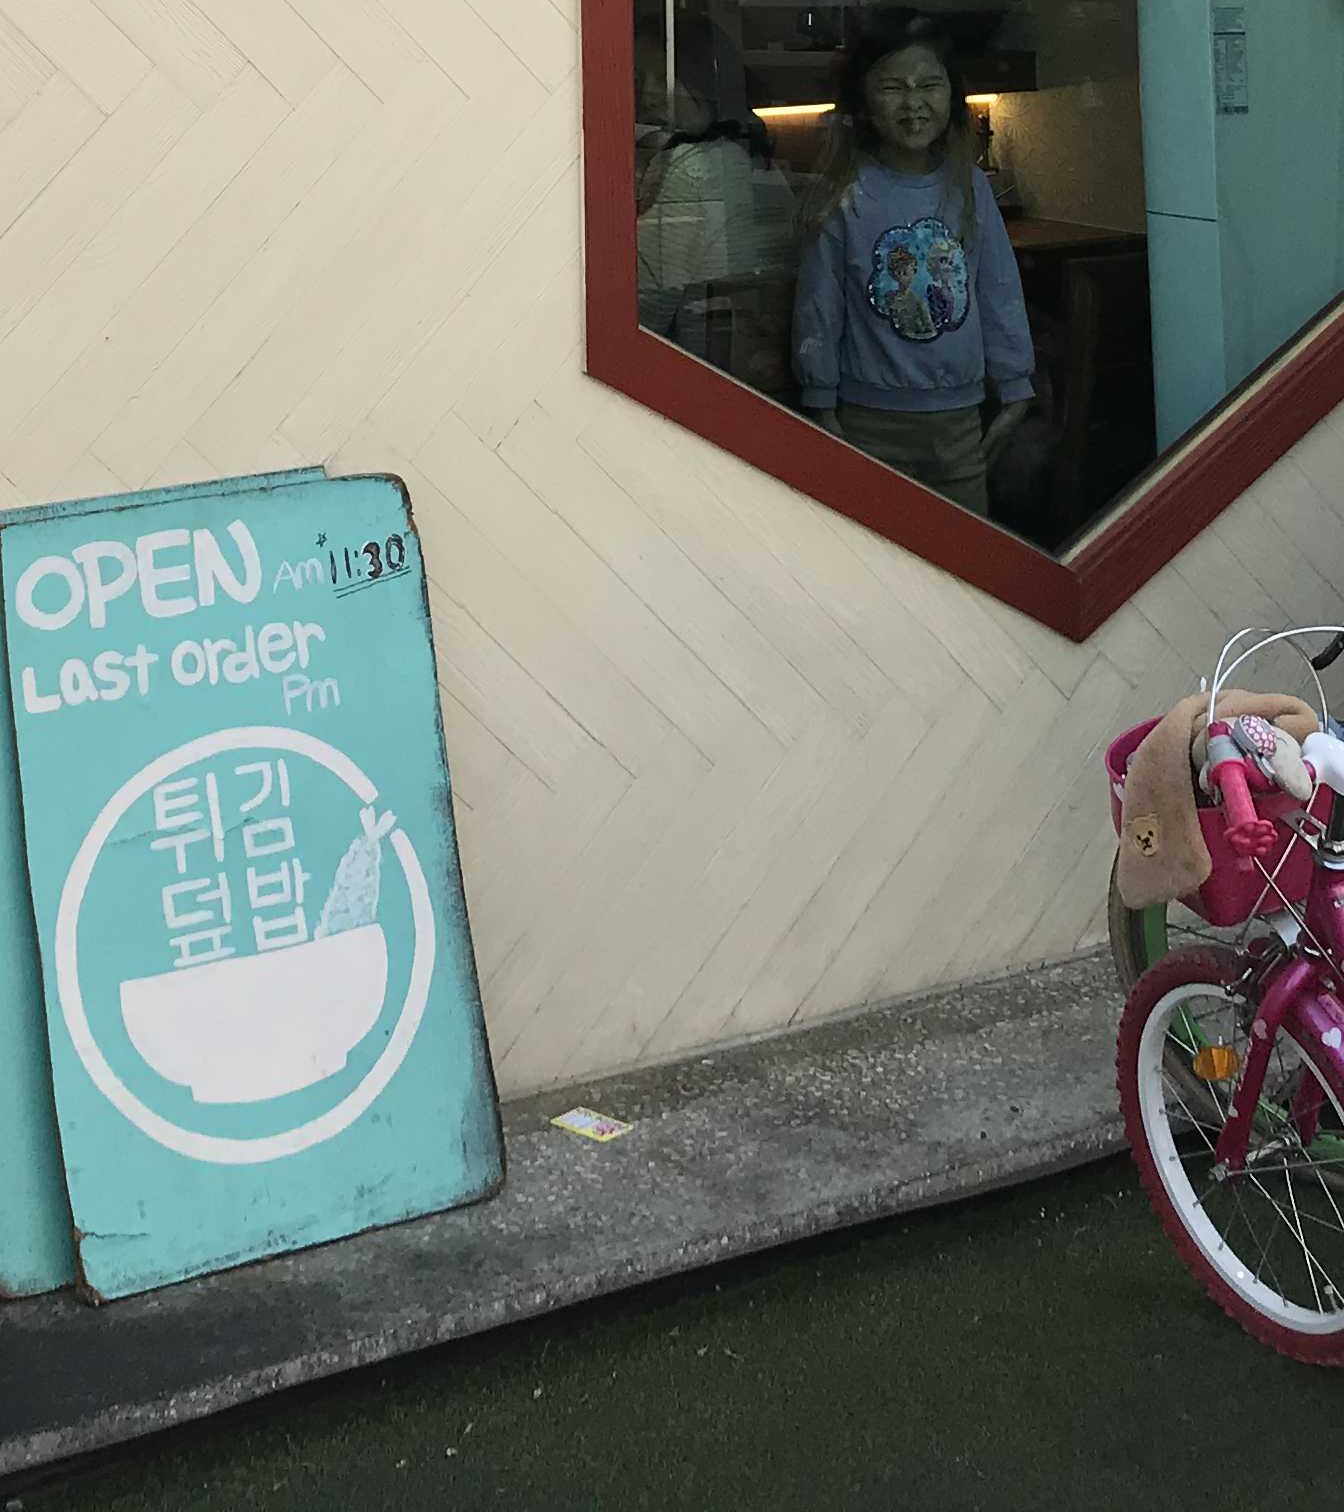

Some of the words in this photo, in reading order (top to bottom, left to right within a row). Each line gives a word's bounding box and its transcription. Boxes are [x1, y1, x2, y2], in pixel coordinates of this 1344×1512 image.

[15, 519, 263, 631] OPEN
[329, 533, 407, 585] 11:30
[22, 644, 160, 714] Last
[170, 620, 327, 686] order
[282, 674, 342, 717] Pm
